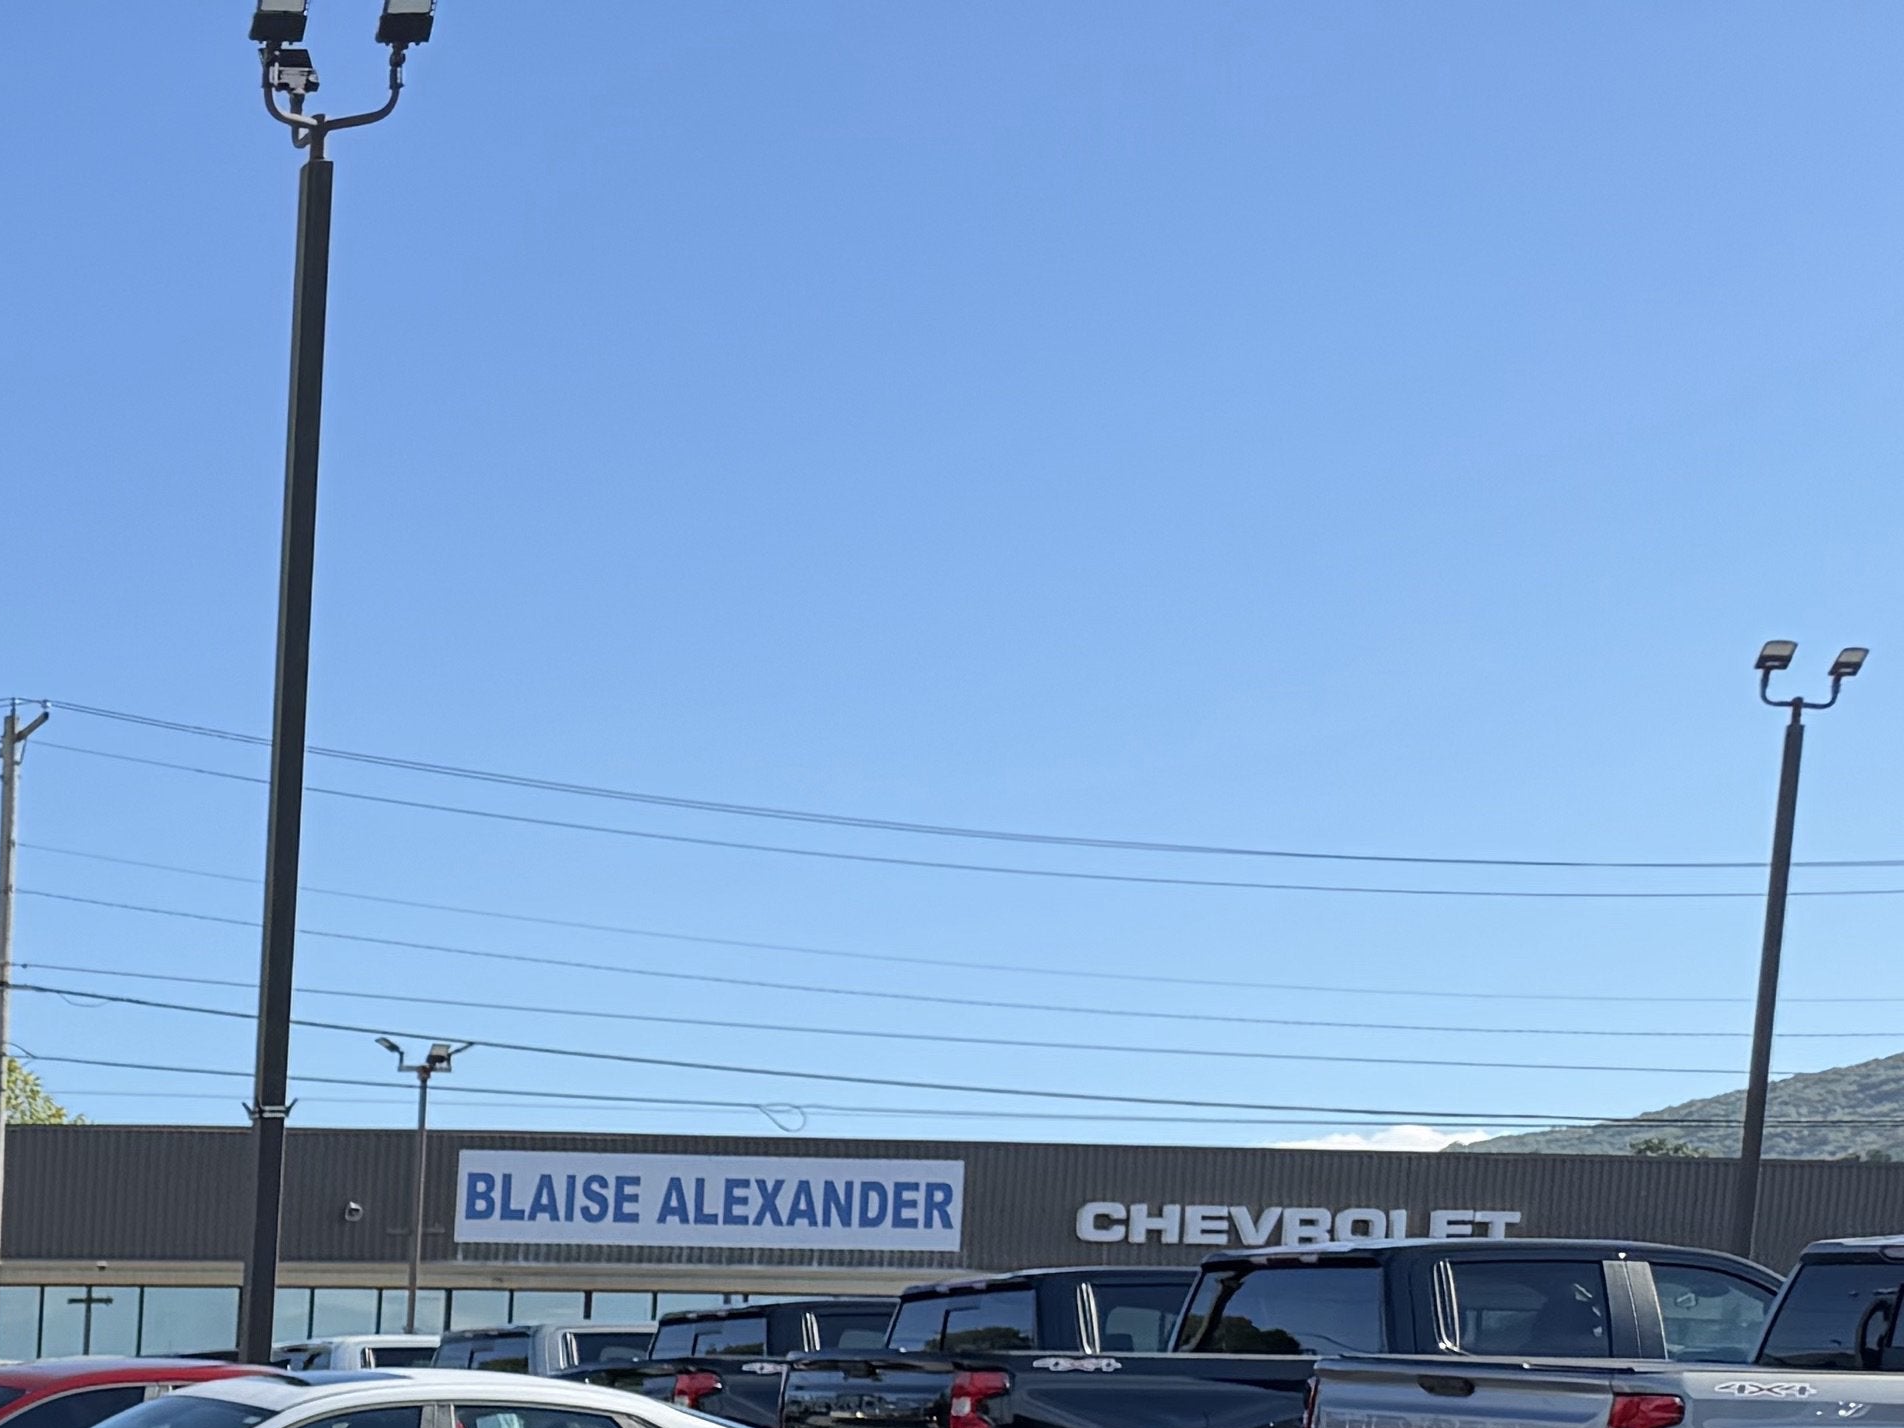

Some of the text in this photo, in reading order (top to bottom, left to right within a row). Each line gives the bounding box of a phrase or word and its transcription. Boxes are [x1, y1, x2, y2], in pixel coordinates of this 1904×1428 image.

[464, 1171, 954, 1230] BLAISE ALEXANDER
[1075, 1201, 1521, 1247] CHEVROLET
